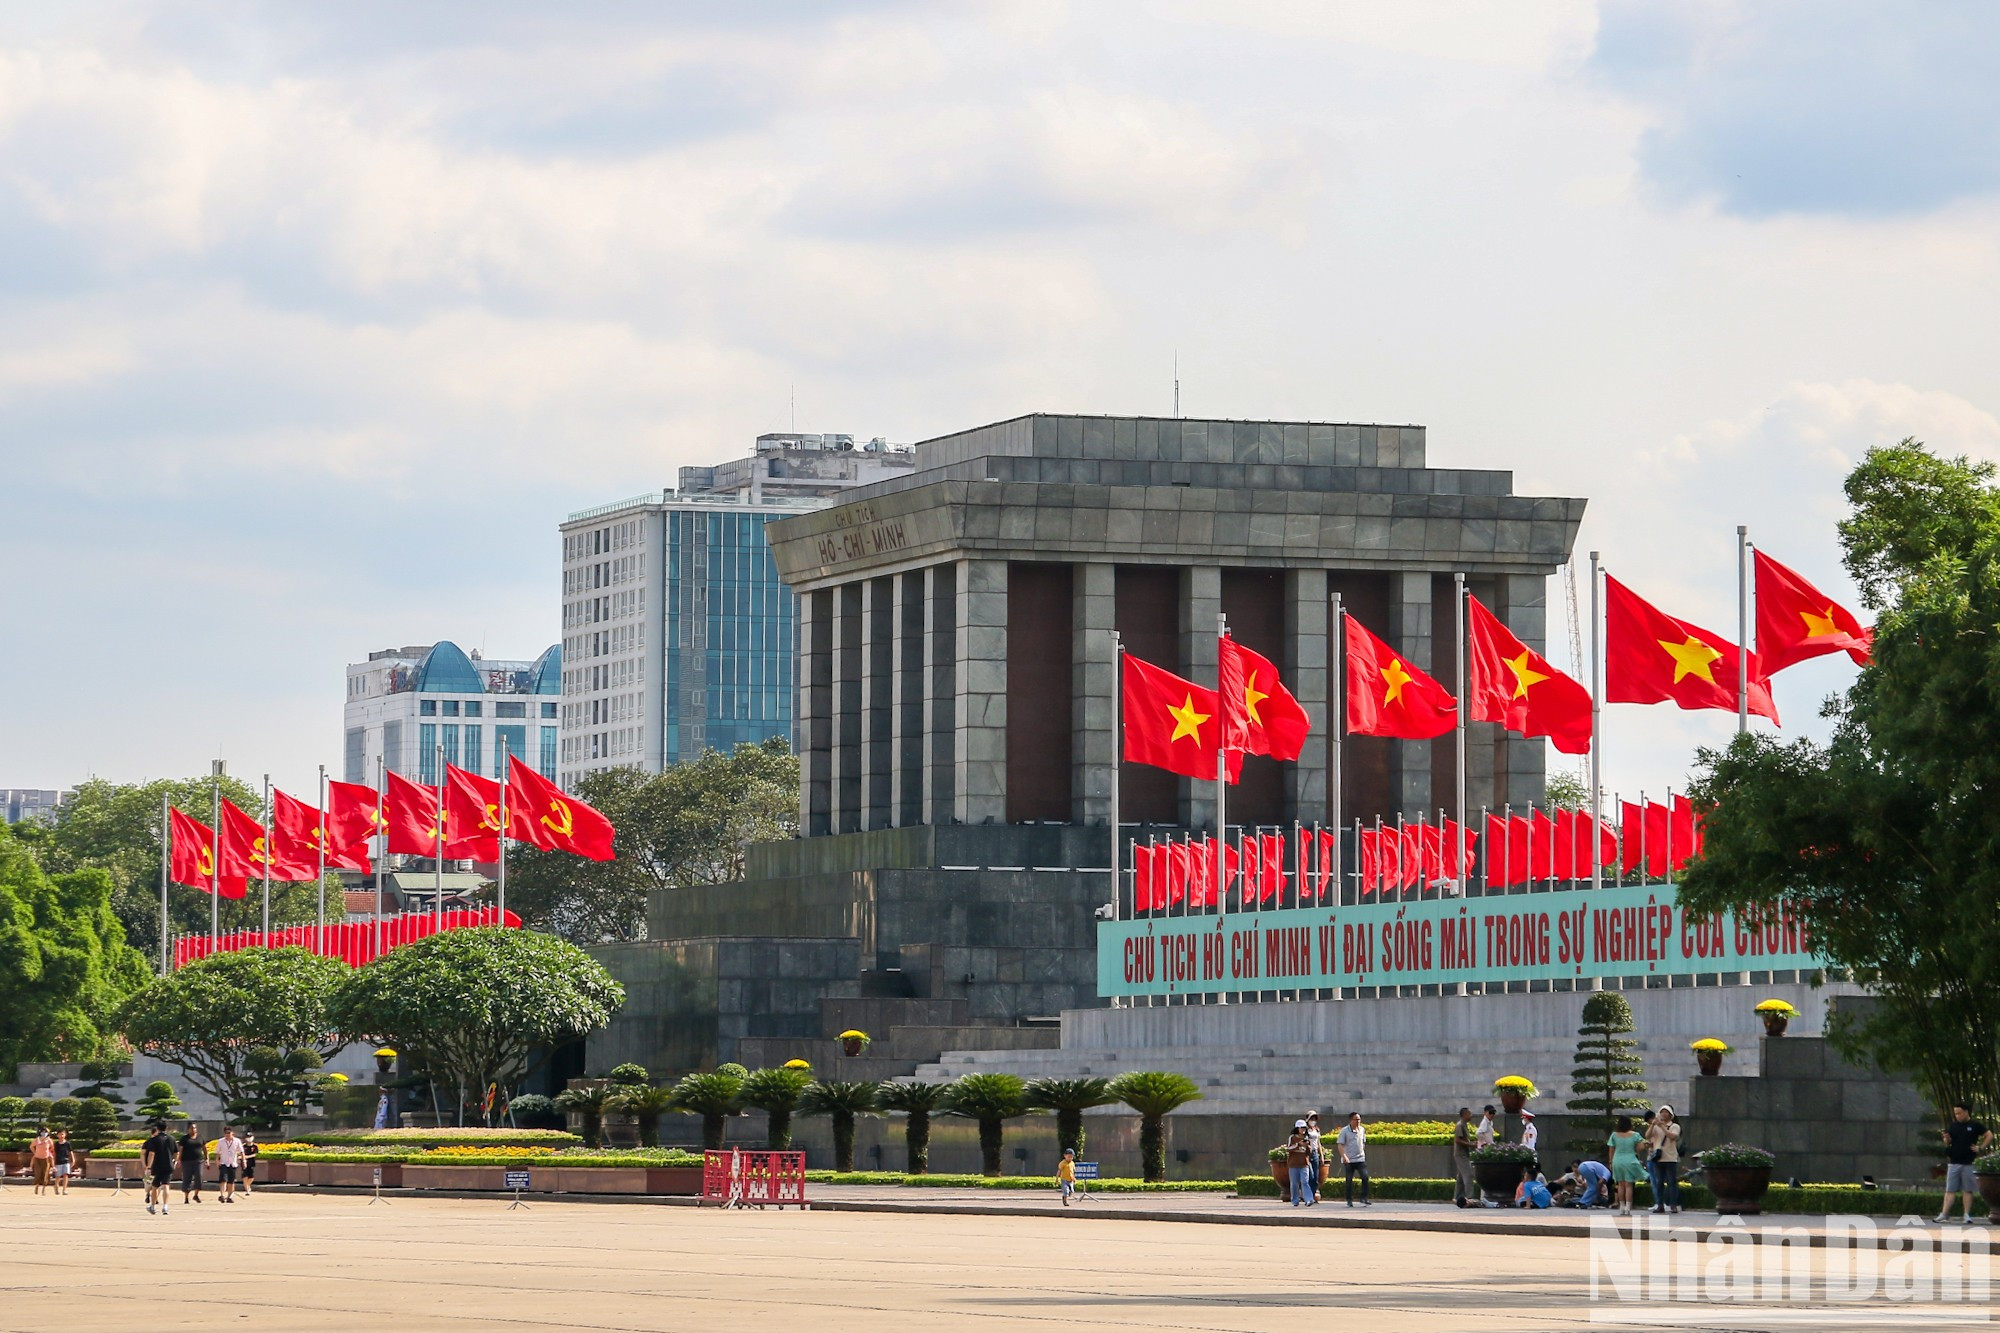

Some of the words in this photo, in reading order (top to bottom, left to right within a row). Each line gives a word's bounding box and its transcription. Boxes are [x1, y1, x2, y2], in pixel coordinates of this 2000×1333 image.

[1124, 921, 1155, 984] CHỦ
[1161, 933, 1196, 991] TỊCH
[1203, 916, 1224, 981] HỒ
[1231, 919, 1259, 979] CHÍ
[1265, 927, 1311, 978] MINH
[1318, 914, 1336, 975] VĨ
[1343, 922, 1374, 983] ĐẠI
[1381, 905, 1432, 973] SỐNG
[1440, 906, 1477, 970] MÃI
[1485, 912, 1550, 968] TRONG
[1558, 901, 1587, 975] SỰ
[1593, 894, 1673, 972] NGHIỆP
